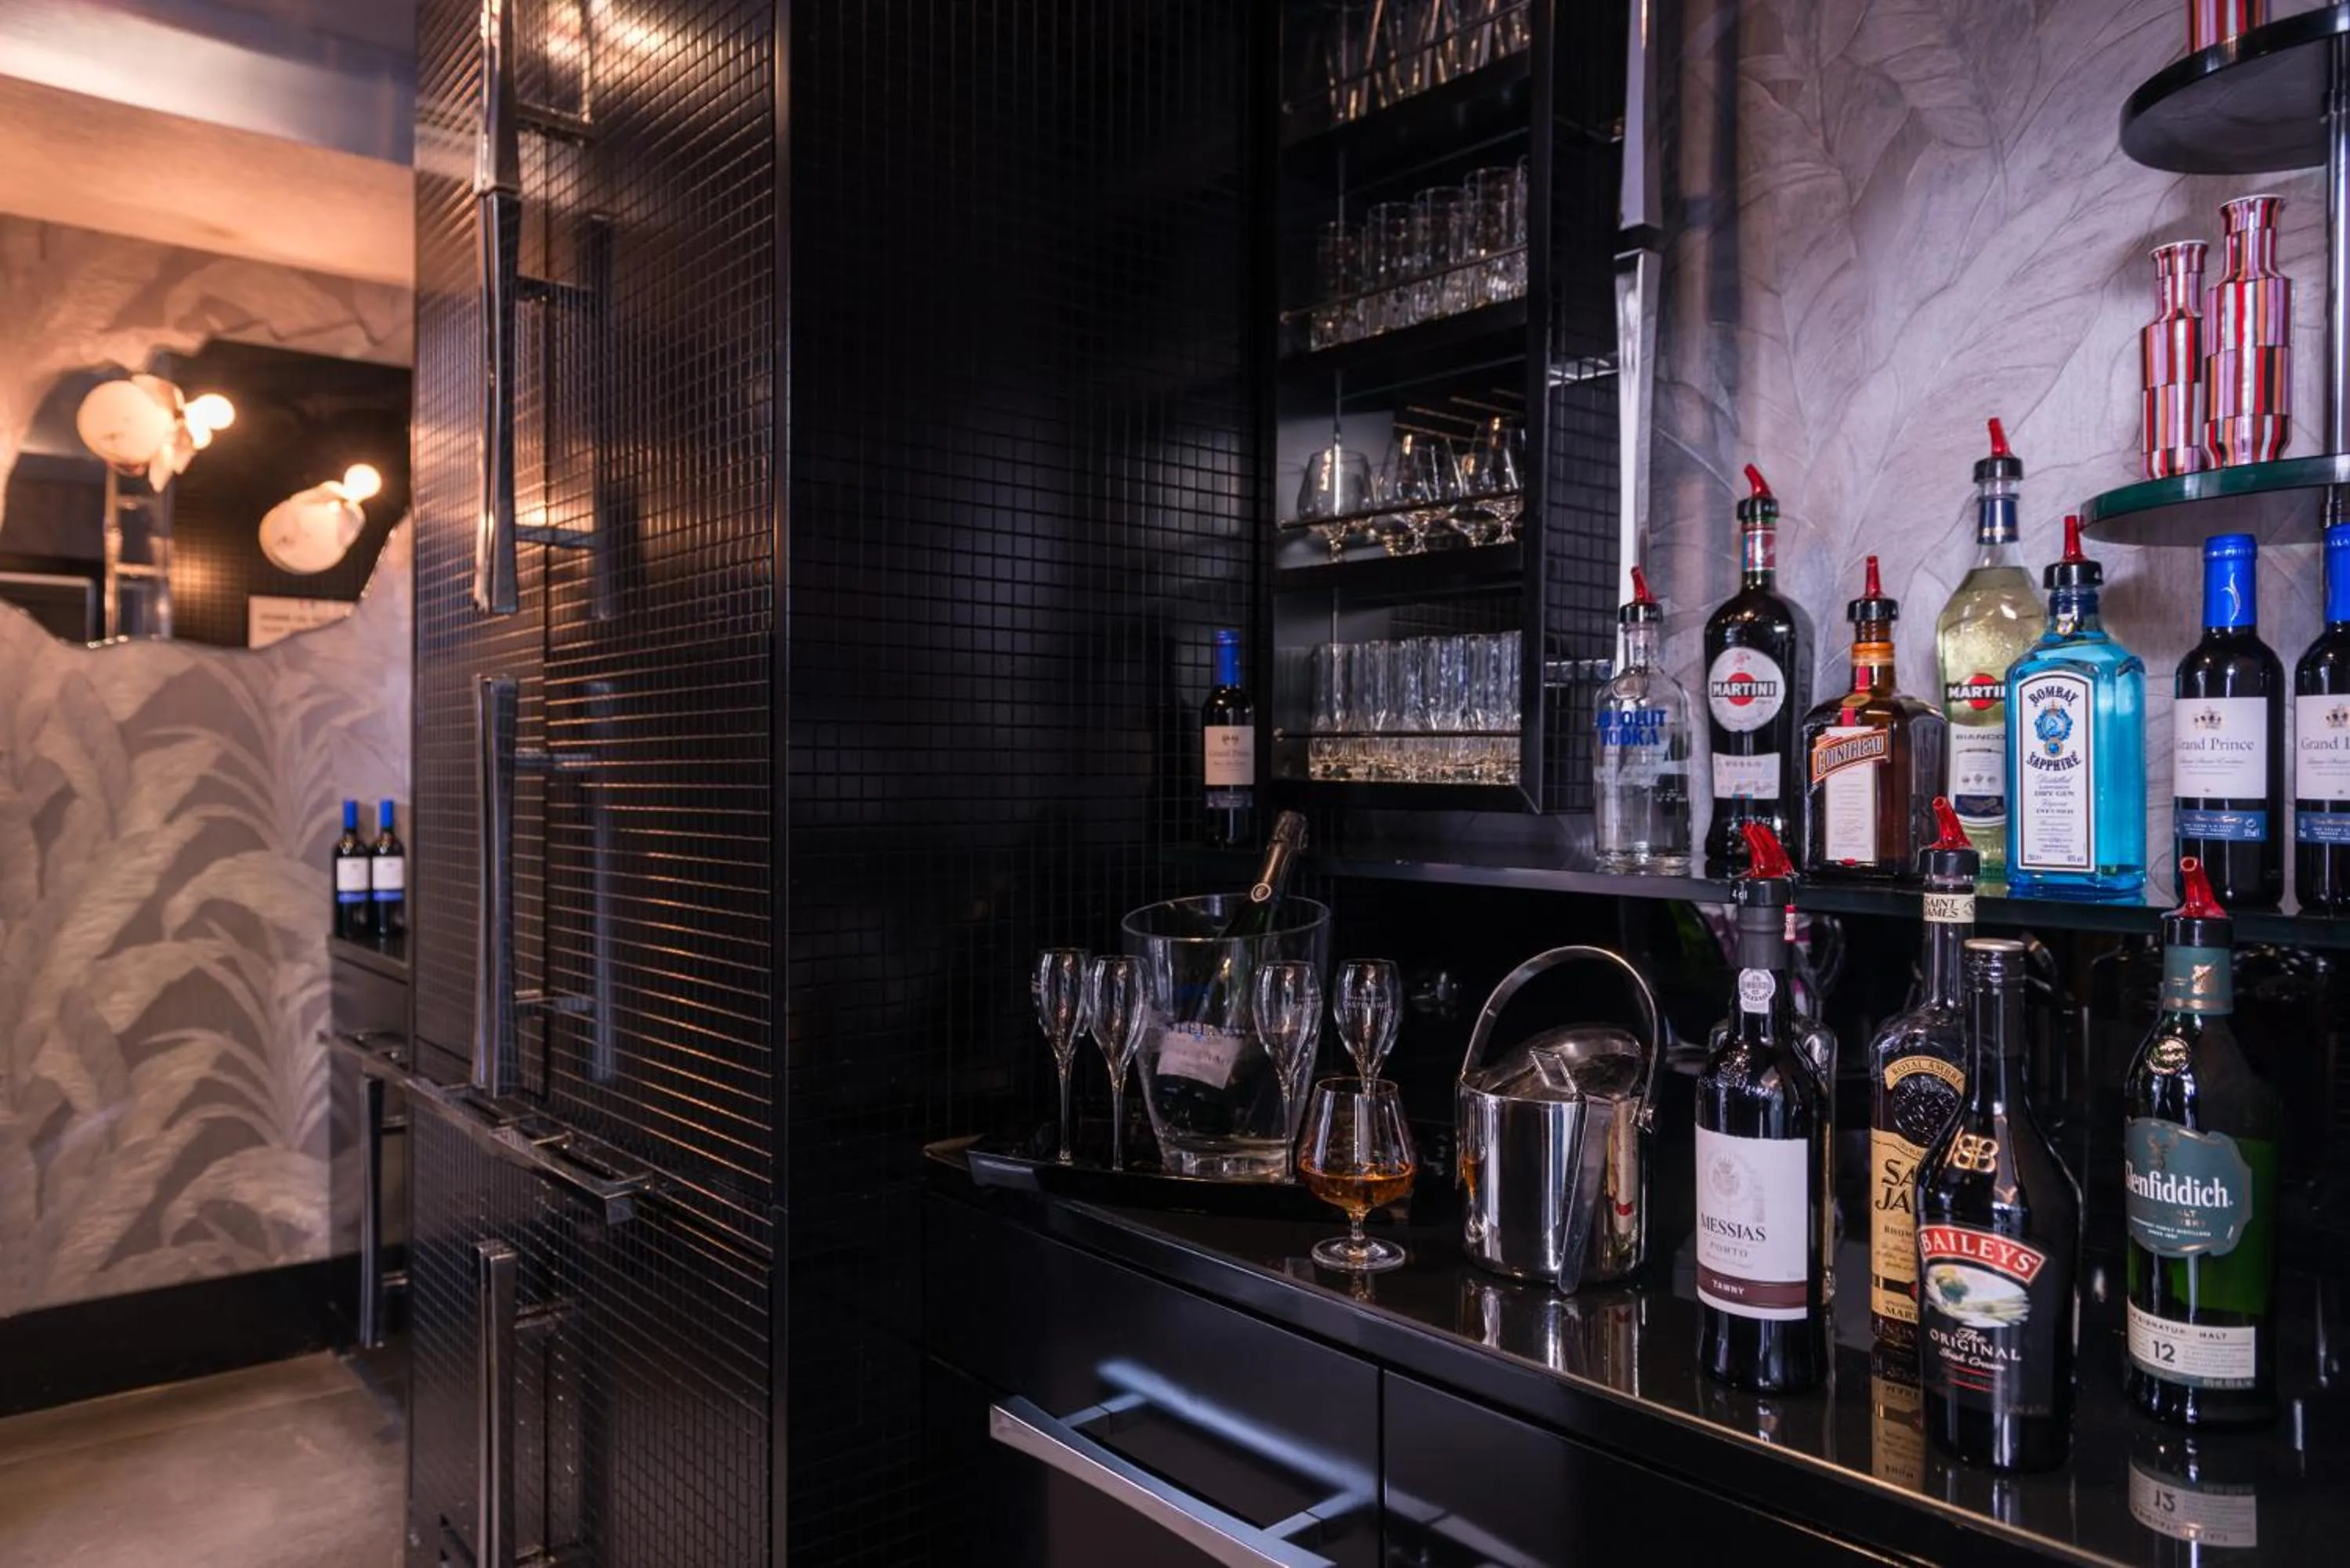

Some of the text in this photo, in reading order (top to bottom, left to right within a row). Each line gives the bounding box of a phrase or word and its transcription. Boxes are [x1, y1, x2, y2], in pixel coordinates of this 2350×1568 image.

[1713, 681, 1775, 696] MARTINI
[2027, 685, 2079, 707] BOMBAY
[1595, 709, 1667, 728] ABSOLUT
[1600, 727, 1660, 746] VODKA
[2209, 737, 2254, 750] Prince
[1817, 735, 1884, 775] COINTREAU
[2026, 749, 2081, 771] SAPPHIRE
[1892, 1060, 1924, 1076] ROYAL
[1701, 1212, 1766, 1241] MESSIAS
[1710, 1241, 1748, 1258] PORTO
[1920, 1231, 2035, 1273] BAILEYS
[1712, 1279, 1745, 1295] TAWNY
[1929, 1328, 2022, 1361] ORIGINAL
[2199, 1332, 2227, 1341] MALT
[2153, 1340, 2175, 1364] 12
